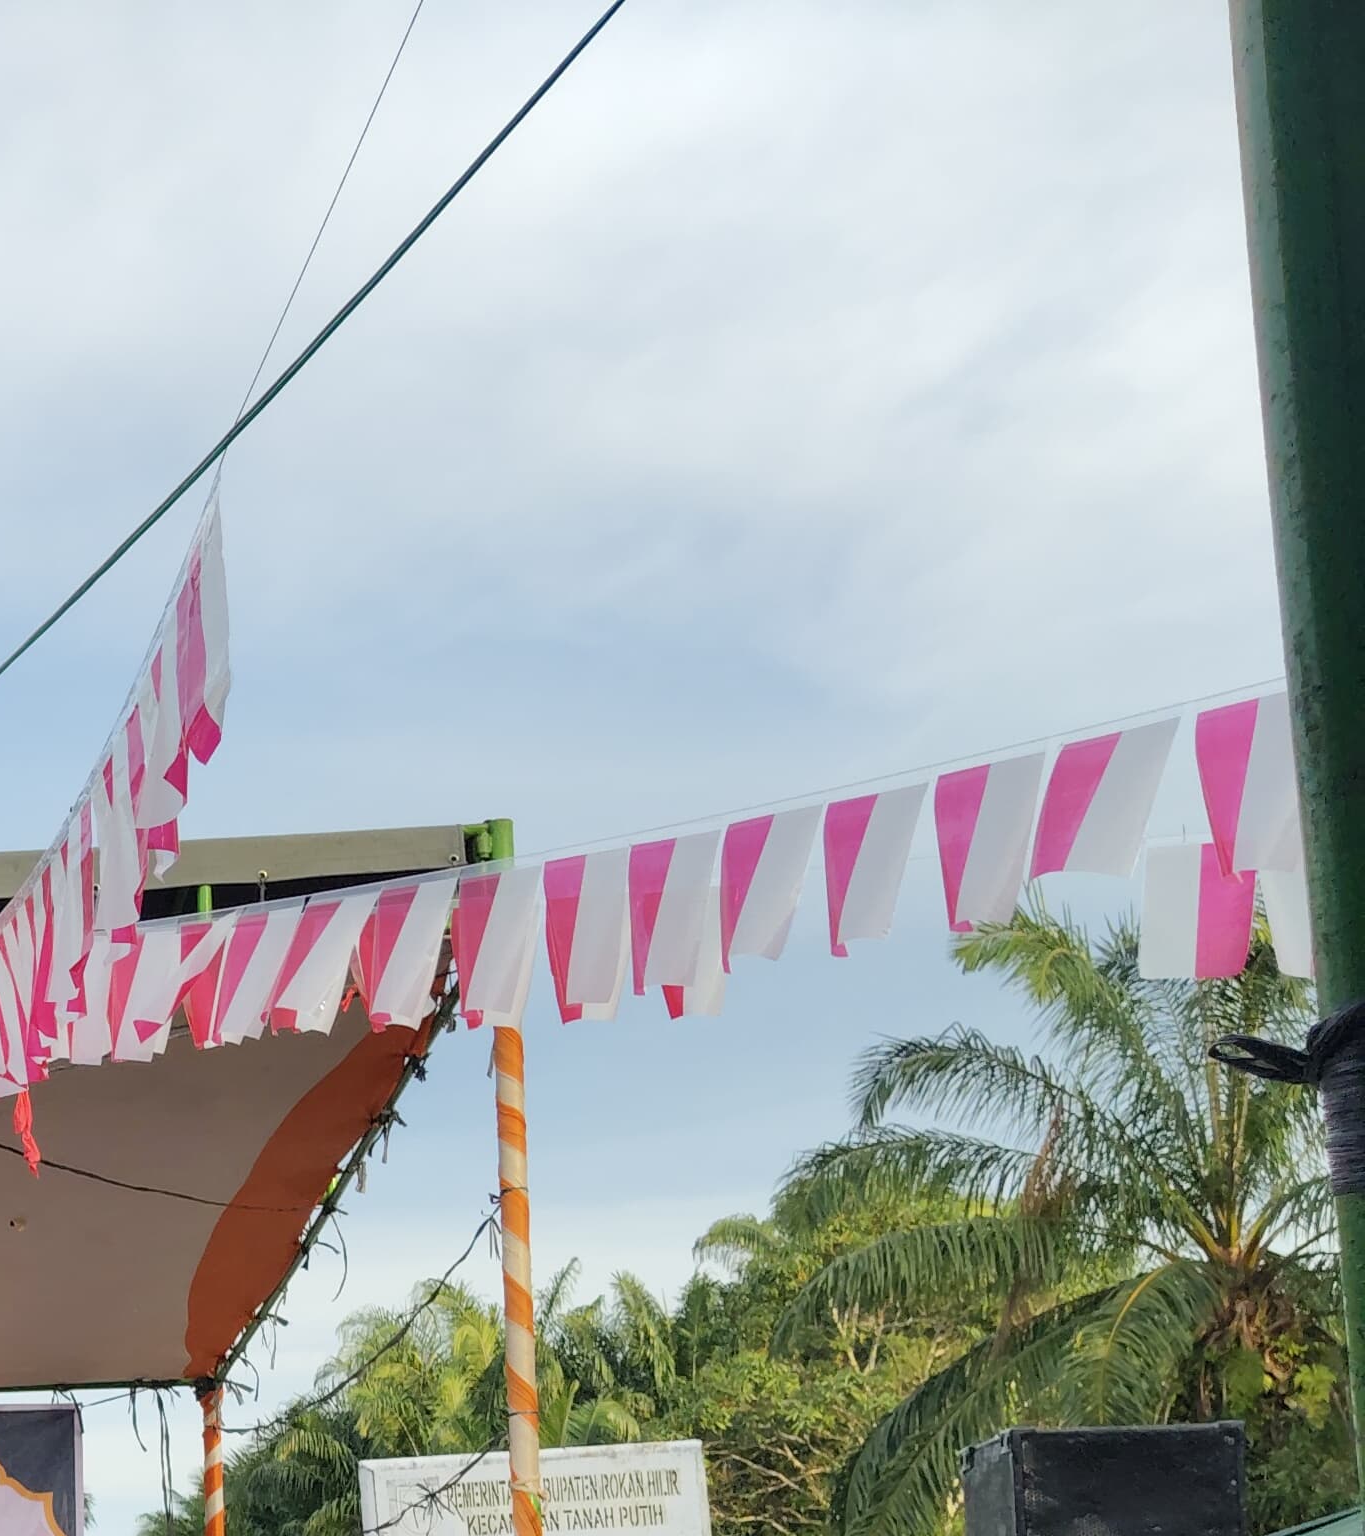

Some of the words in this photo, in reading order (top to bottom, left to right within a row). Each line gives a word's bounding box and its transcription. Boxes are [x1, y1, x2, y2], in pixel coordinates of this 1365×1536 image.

[447, 1478, 513, 1509] PEMERINTA
[542, 1473, 600, 1502] BUPATEN
[468, 1510, 559, 1536] KECAAN
[563, 1507, 614, 1530] TANAH
[619, 1504, 664, 1527] PUTIH
